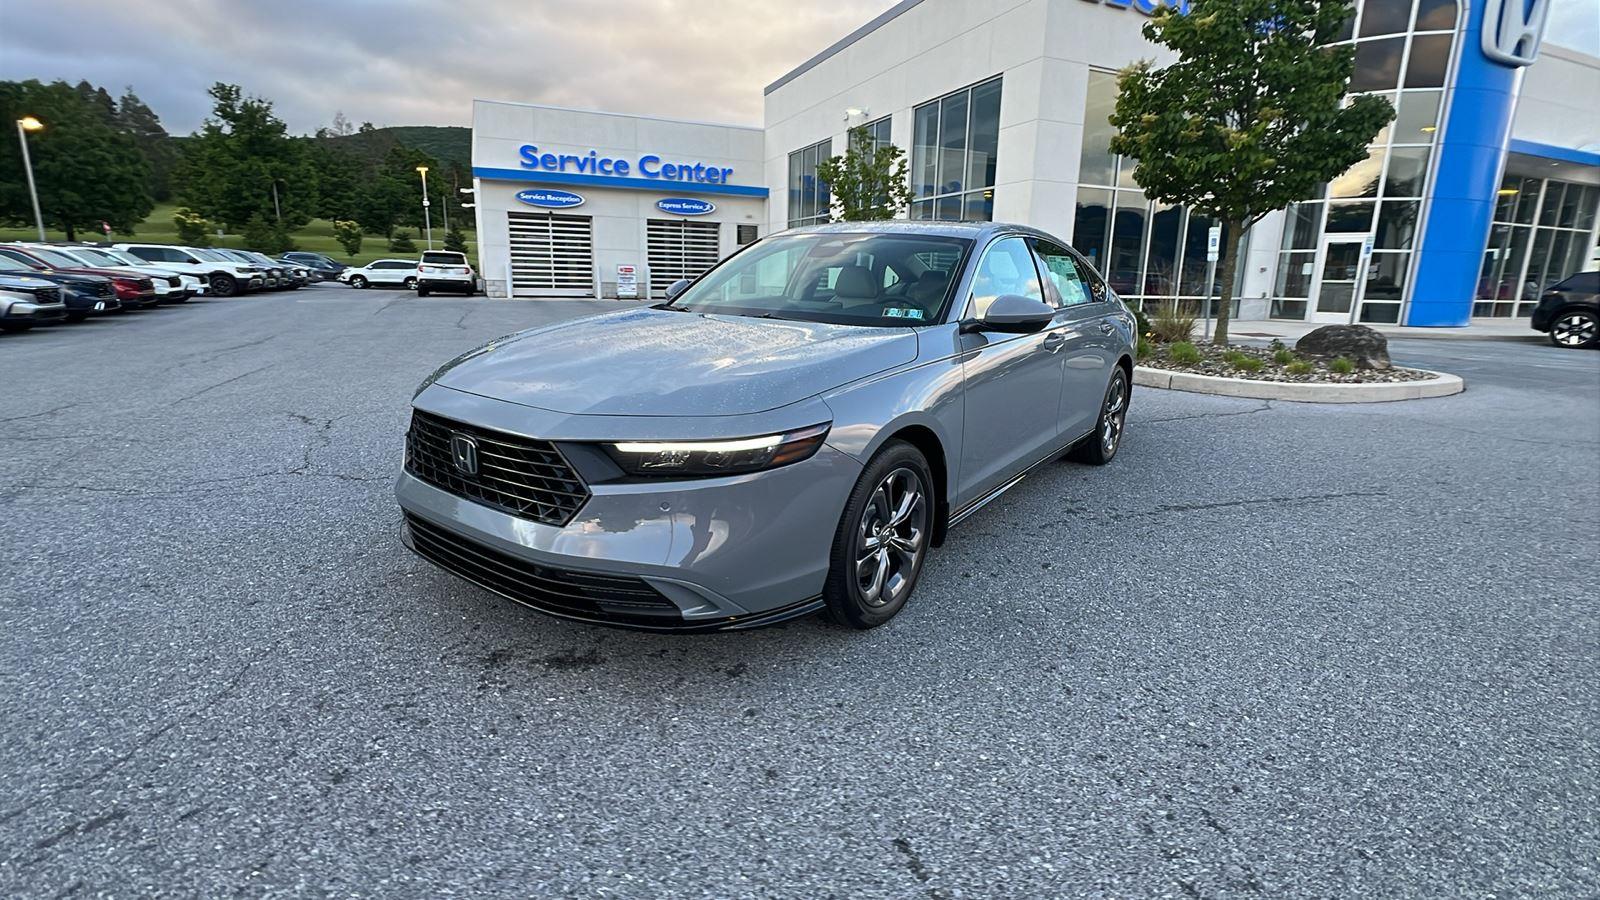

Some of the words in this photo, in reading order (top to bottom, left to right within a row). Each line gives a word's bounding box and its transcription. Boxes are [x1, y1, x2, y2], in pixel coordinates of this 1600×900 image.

[519, 145, 630, 175] Service
[638, 155, 733, 184] Center
[520, 192, 545, 200] Service
[547, 194, 580, 203] Reception
[659, 201, 681, 209] Express
[682, 202, 703, 210] Service
